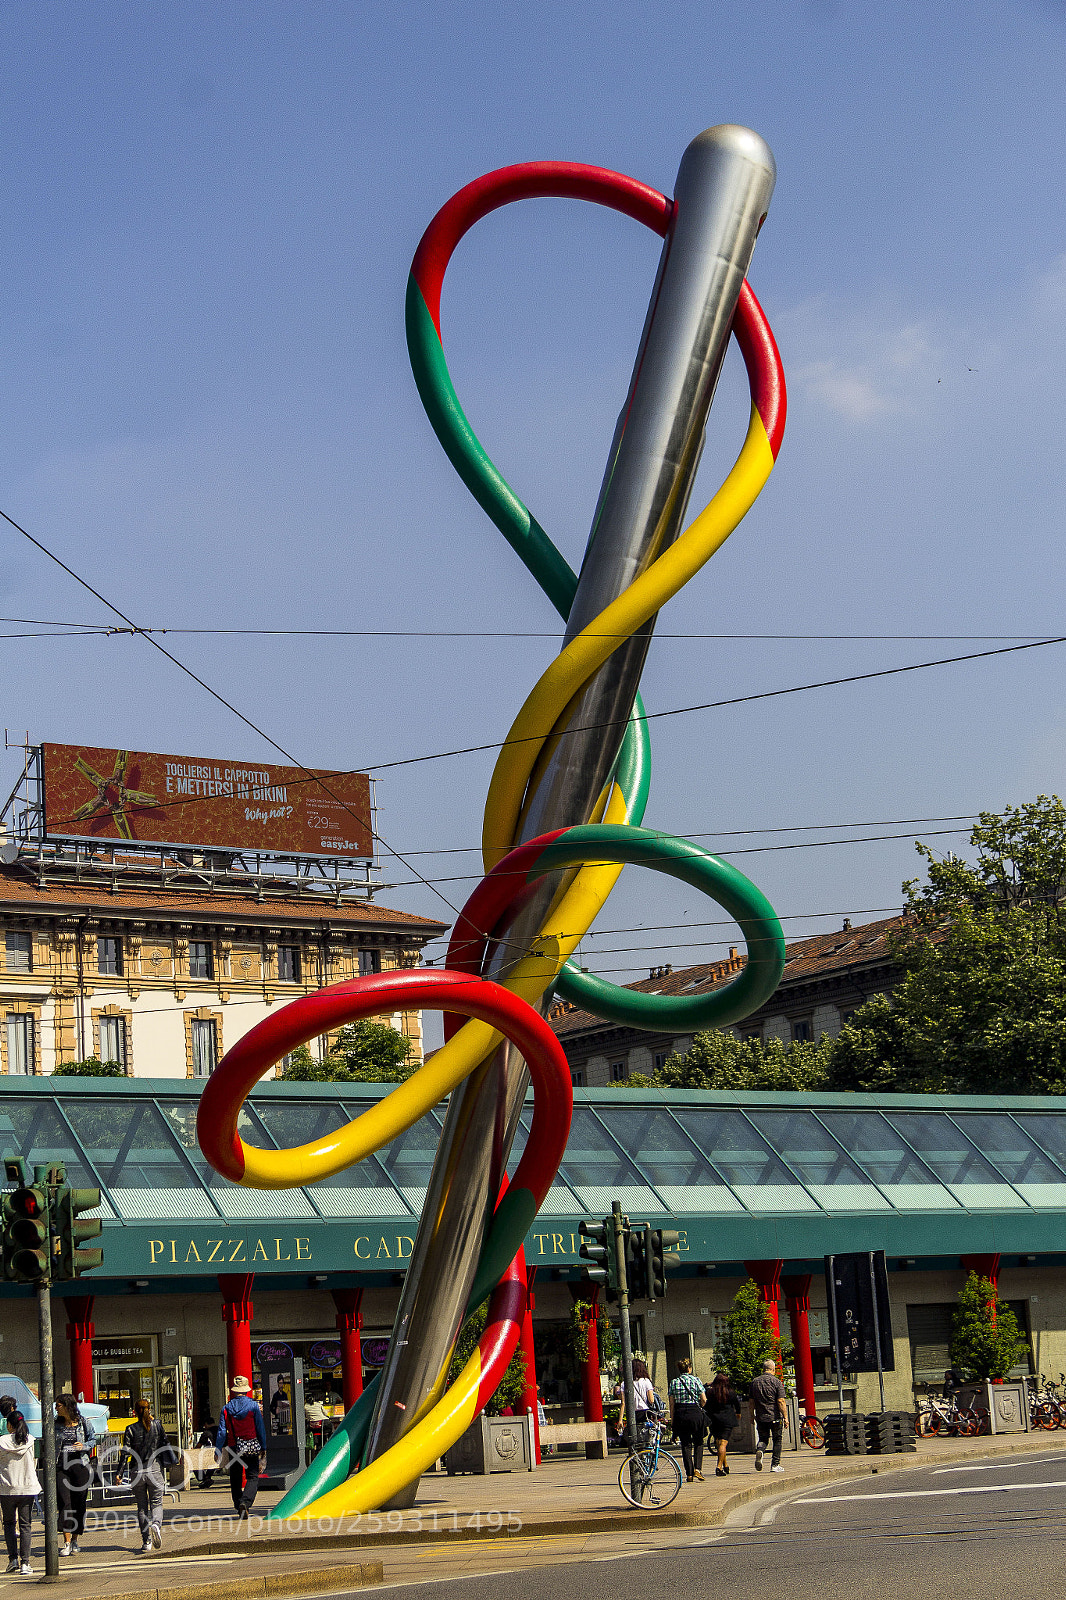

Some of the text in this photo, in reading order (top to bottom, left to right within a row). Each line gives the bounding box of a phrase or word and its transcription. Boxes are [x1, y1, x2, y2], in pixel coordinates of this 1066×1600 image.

[165, 763, 270, 785] TOGLIERSI IL CAPPOTTO
[166, 777, 173, 793] E
[177, 777, 234, 799] METTERSI
[237, 783, 249, 800] IN
[252, 784, 288, 803] BIKINI
[244, 807, 268, 825] Why
[269, 806, 293, 819] not?
[320, 840, 359, 851] easyJet
[148, 1237, 313, 1263] PIAZZALE
